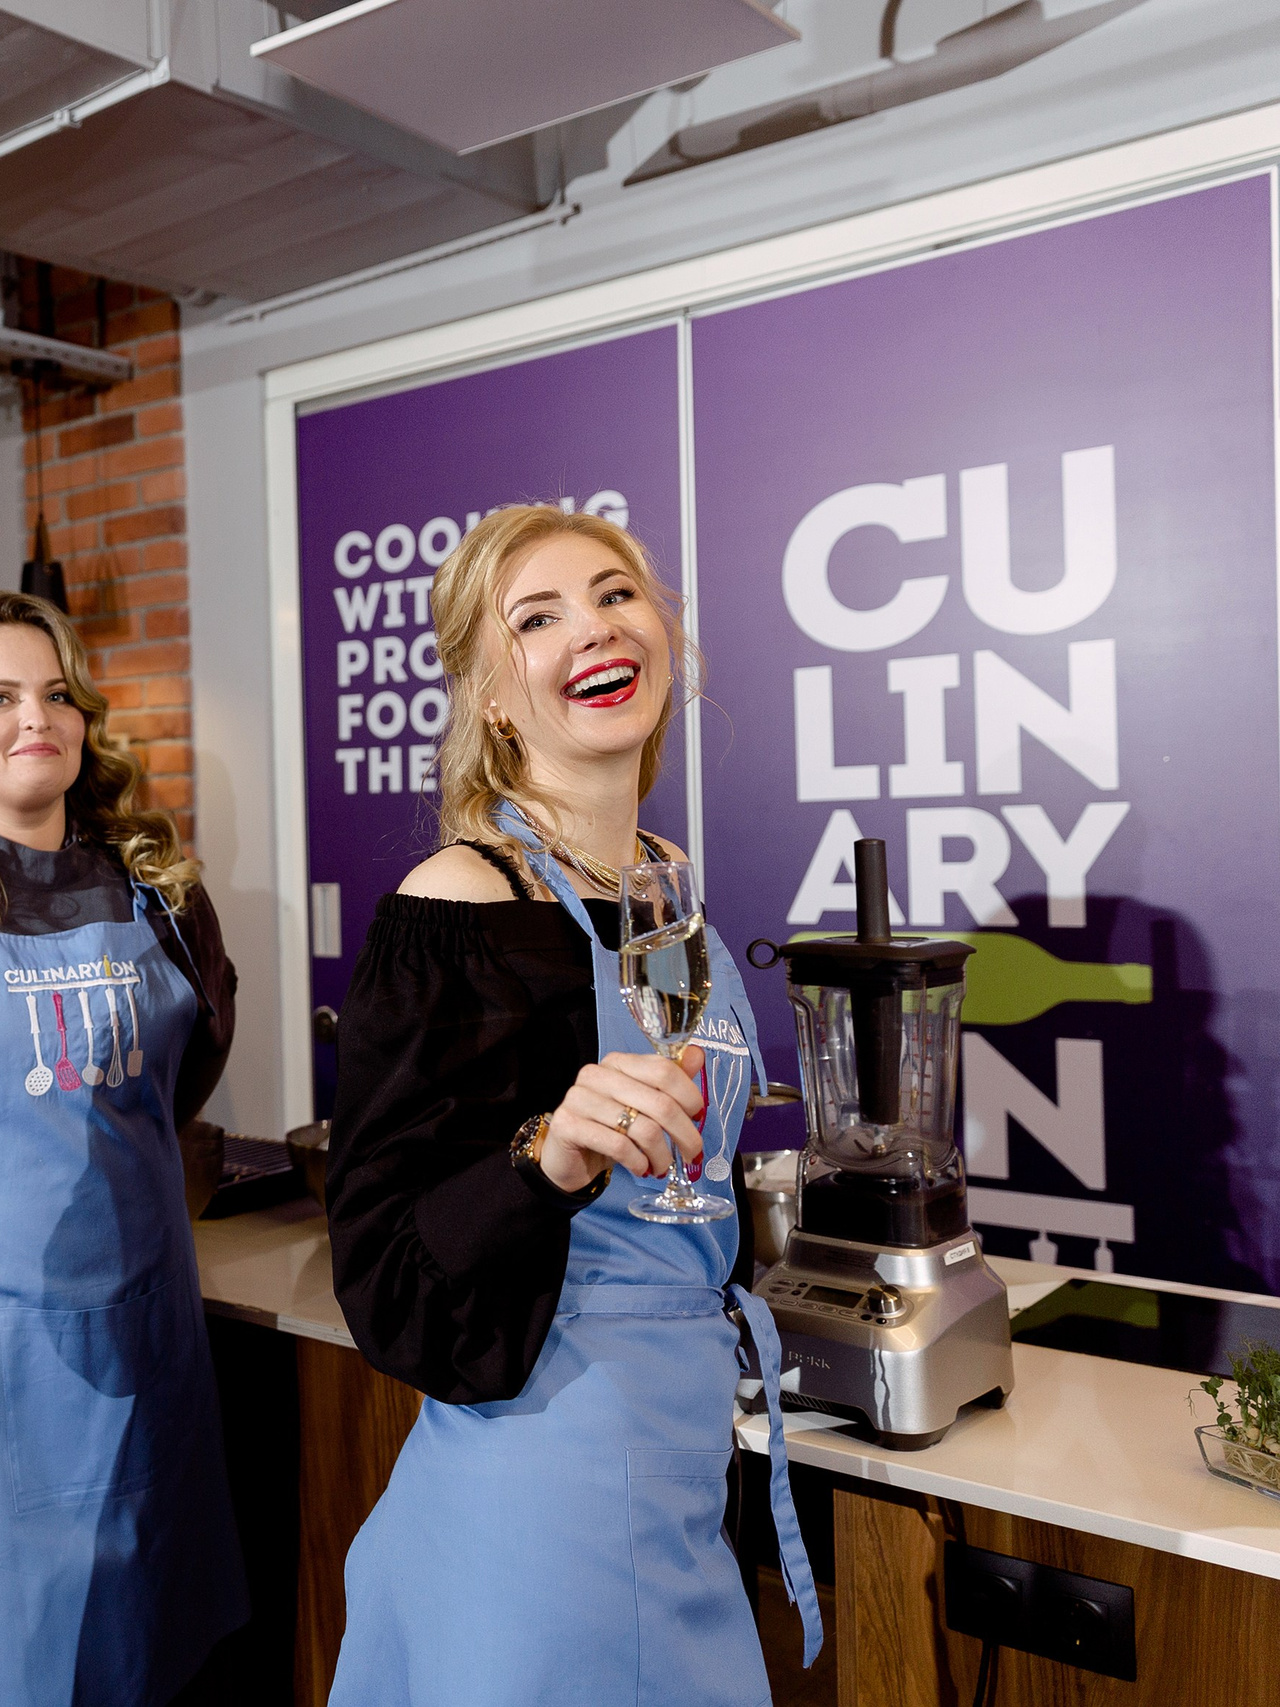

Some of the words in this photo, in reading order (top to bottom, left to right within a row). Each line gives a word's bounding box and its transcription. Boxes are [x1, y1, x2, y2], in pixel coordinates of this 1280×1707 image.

[333, 489, 629, 579] COOG
[782, 444, 1117, 652] CU
[793, 638, 1119, 802] LIN
[786, 802, 1131, 928] ARY
